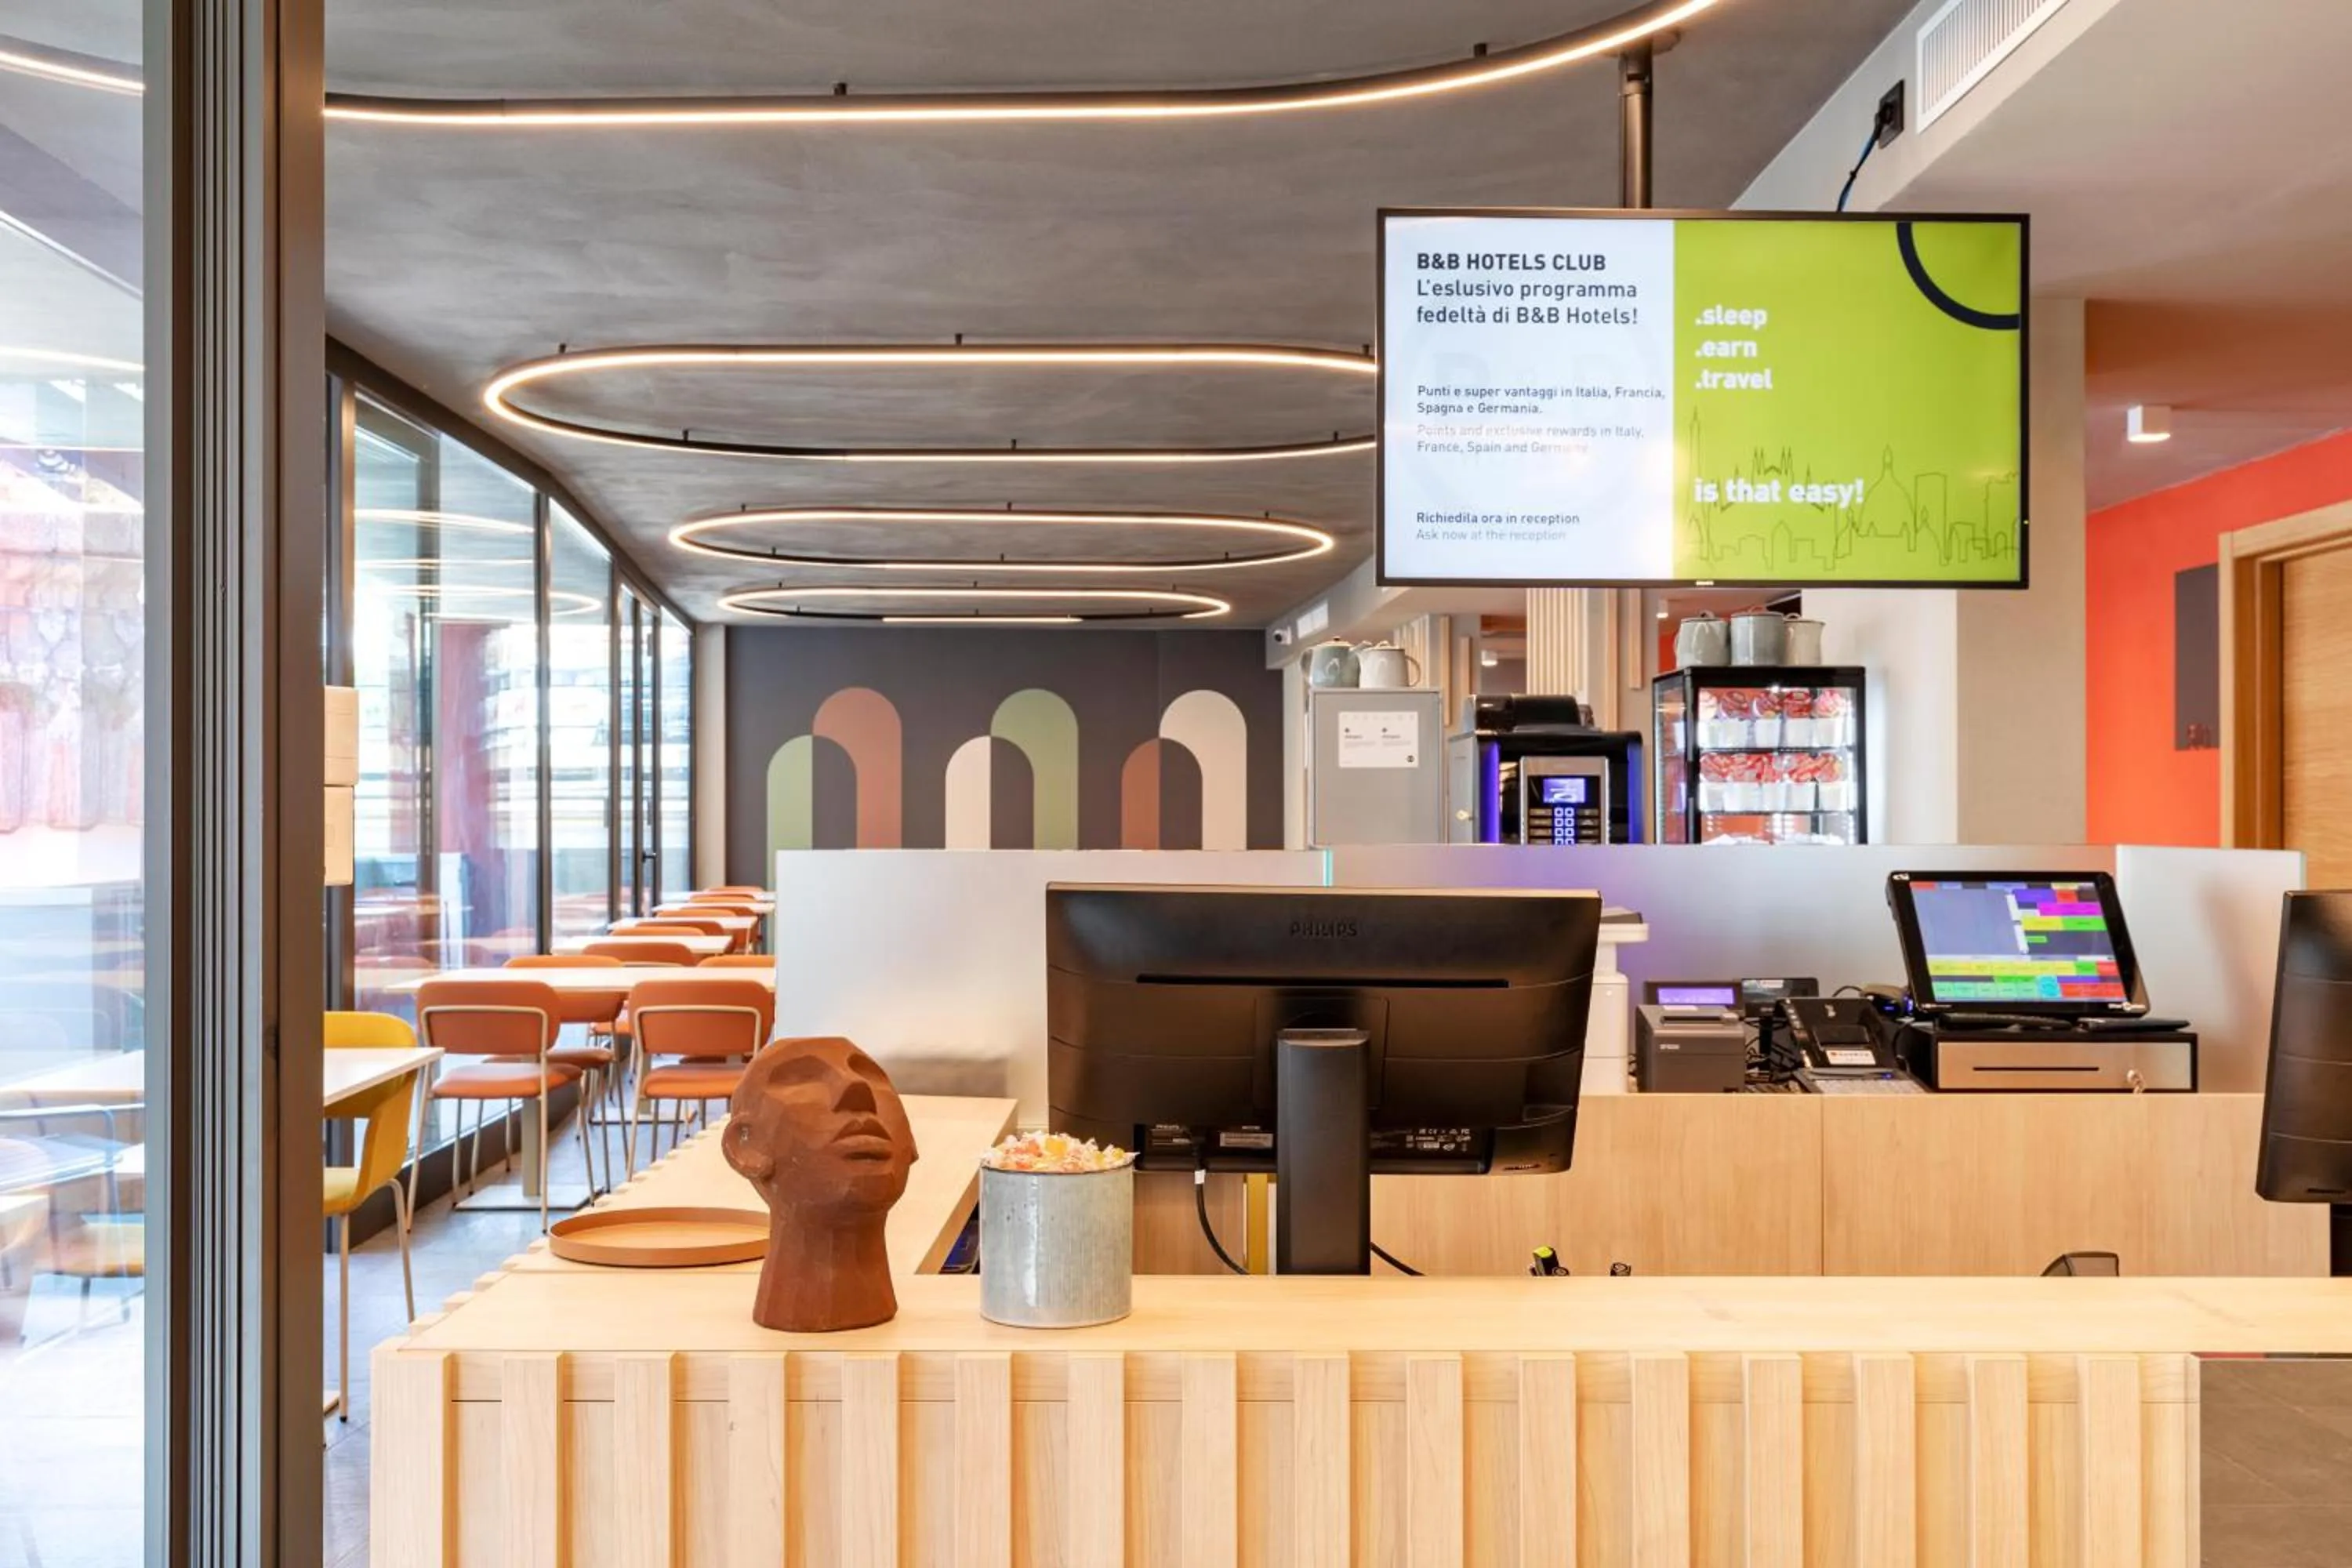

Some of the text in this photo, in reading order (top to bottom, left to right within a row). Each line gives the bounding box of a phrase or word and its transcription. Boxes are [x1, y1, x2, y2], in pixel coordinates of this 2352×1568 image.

[1417, 253, 1606, 270] B&B HOTELS CLUB
[1417, 278, 1637, 301] L'eslusivo programma
[1417, 305, 1639, 325] fedeltà di B&B Hotels!
[1694, 304, 1767, 329] .sleep
[1694, 339, 1759, 358] .earn
[1694, 368, 1773, 390] .travel
[1417, 385, 1665, 401] Punti e super vantaggi in Italia, Francia,
[1417, 402, 1543, 416] Spagna e Germania.
[1459, 424, 1483, 437] and
[1546, 424, 1597, 437] rewards
[1599, 425, 1611, 437] in
[1417, 441, 1464, 455] France,
[1467, 441, 1501, 456] Spain
[1504, 441, 1529, 454] and
[1694, 477, 1864, 509] is that easy!
[1416, 511, 1580, 527] Richiedila ora in reception
[1416, 528, 1438, 541] Ask
[1442, 530, 1467, 541] now
[1488, 528, 1506, 541] the
[1509, 528, 1566, 543] reception
[1290, 920, 1358, 937] PHILIPS
